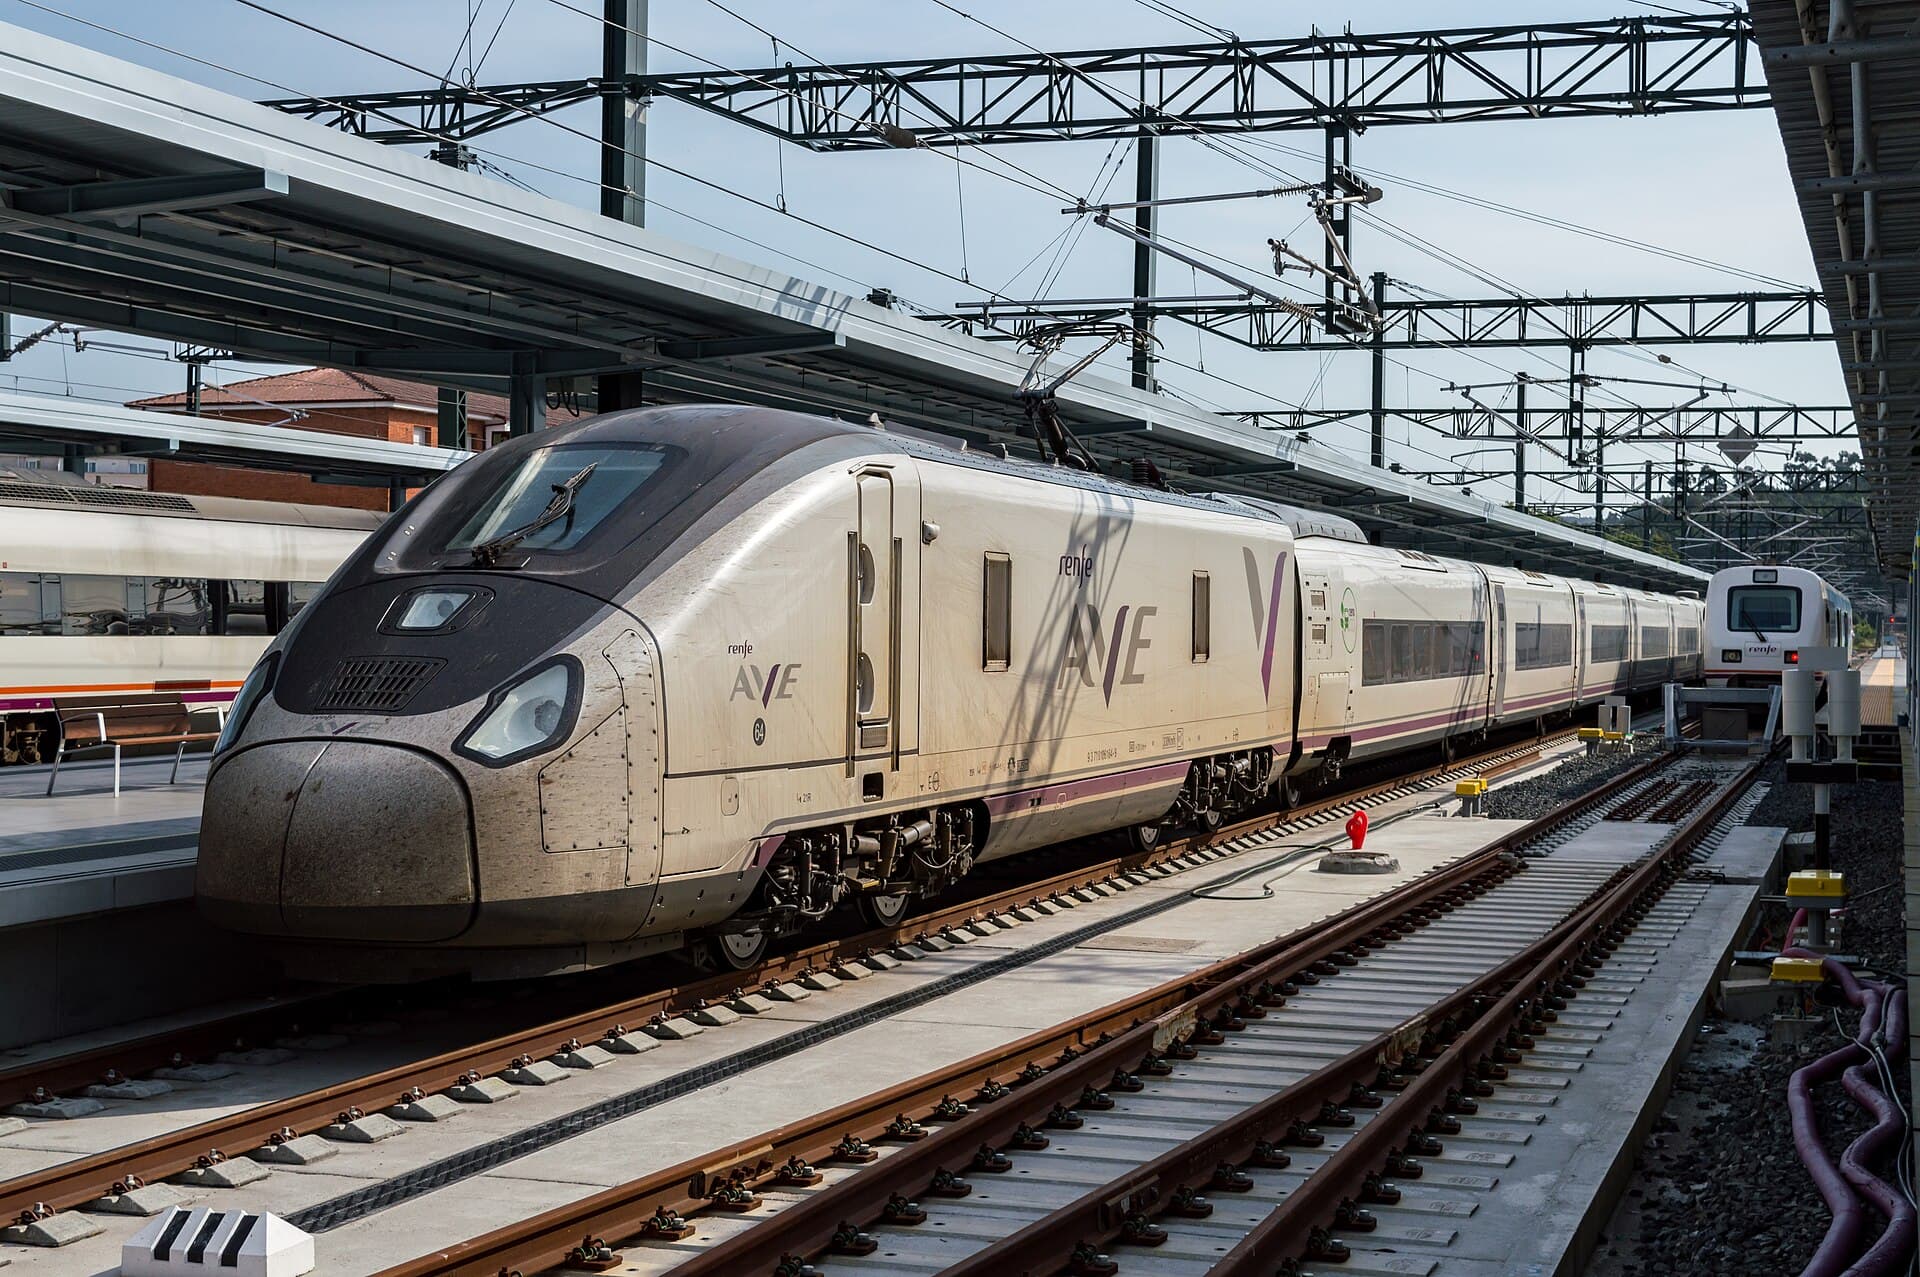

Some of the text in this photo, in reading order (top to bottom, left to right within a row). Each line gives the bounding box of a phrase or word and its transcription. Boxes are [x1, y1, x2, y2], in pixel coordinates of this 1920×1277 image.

[1059, 543, 1093, 589] renfe
[728, 640, 753, 659] renfe
[1057, 603, 1158, 710] AVE
[1749, 645, 1777, 655] renfe
[729, 664, 802, 710] AVE
[754, 722, 765, 741] 64
